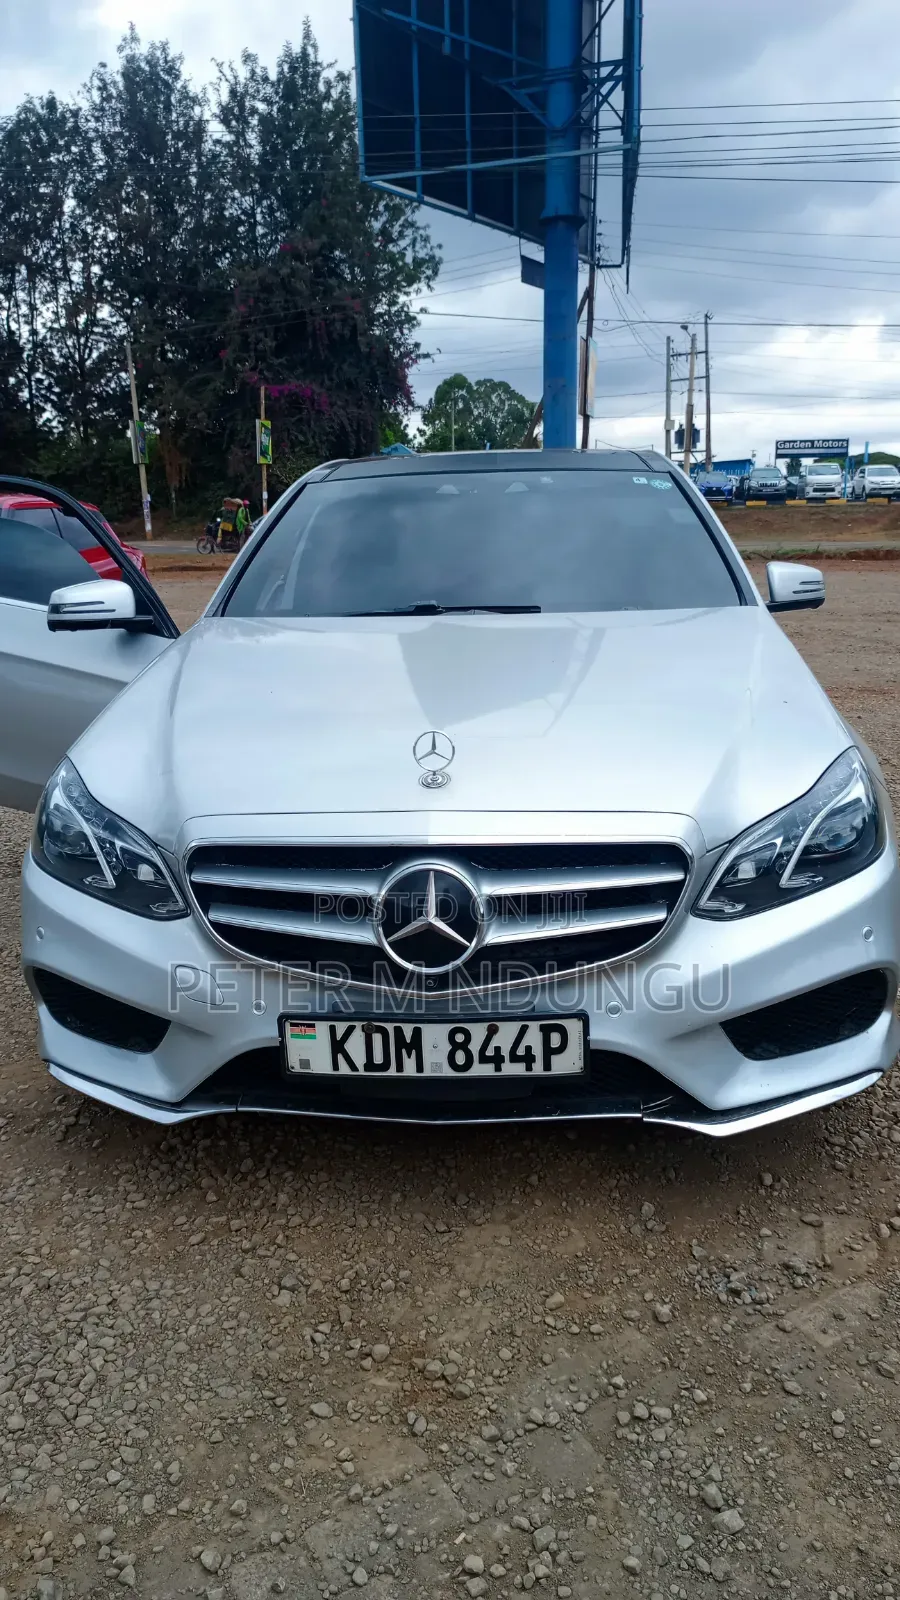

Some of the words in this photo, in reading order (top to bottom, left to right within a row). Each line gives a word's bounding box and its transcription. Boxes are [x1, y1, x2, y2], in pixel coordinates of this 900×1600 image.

[777, 440, 811, 449] Garden
[813, 440, 848, 448] Motors
[328, 1023, 424, 1073] KDM
[447, 1023, 569, 1073] 844P
